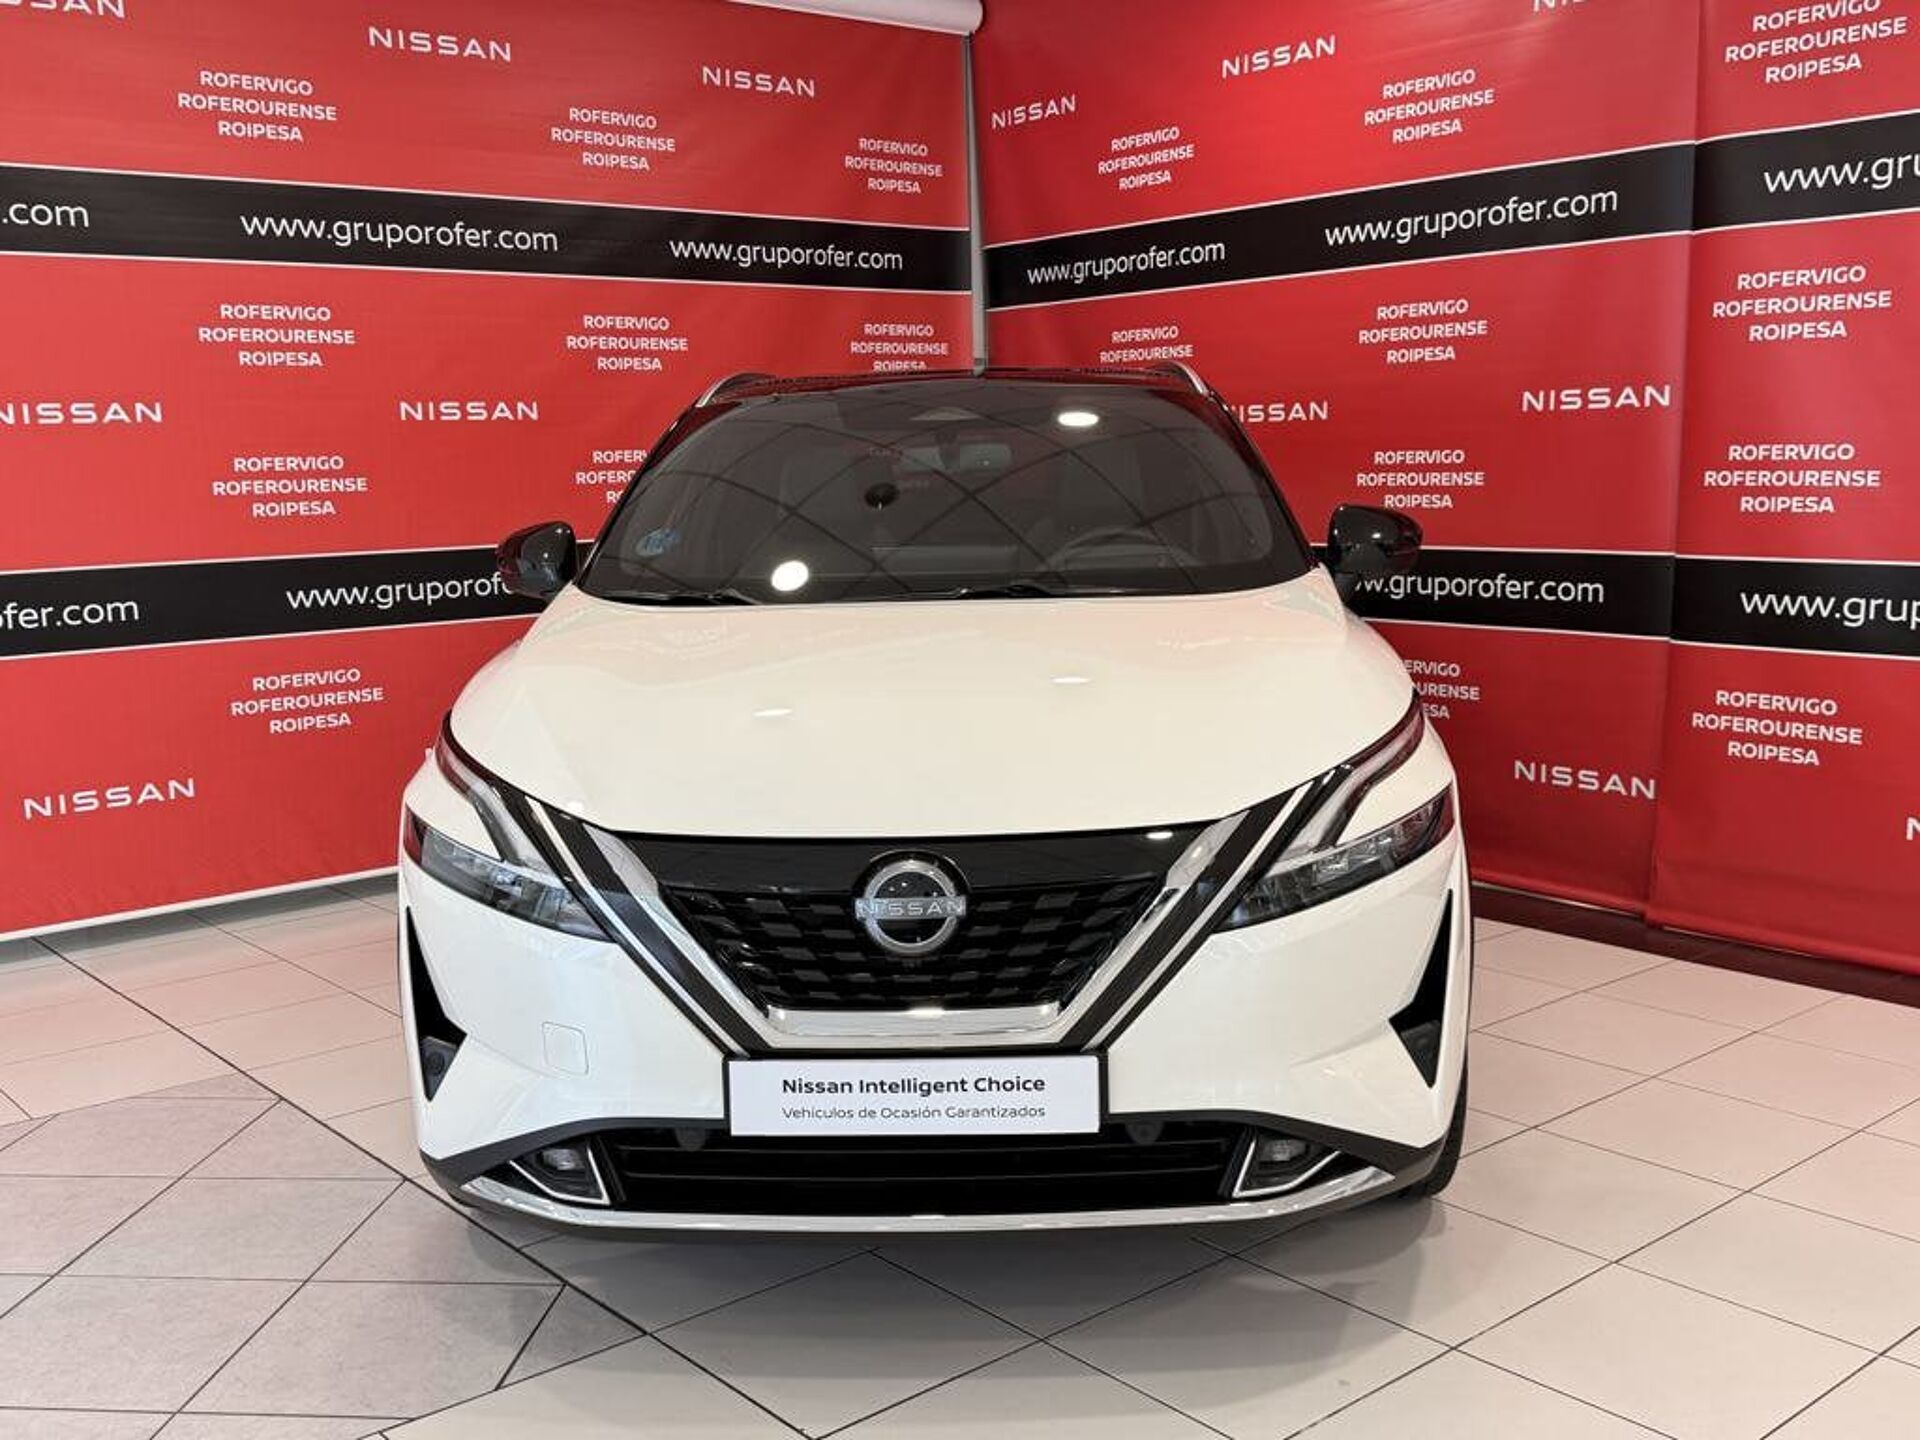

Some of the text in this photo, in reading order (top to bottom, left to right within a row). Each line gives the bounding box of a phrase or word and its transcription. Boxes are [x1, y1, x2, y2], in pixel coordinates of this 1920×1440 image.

[1754, 0, 1881, 31] ROFERVIGO
[369, 27, 510, 61] NISSAN
[1726, 16, 1907, 62] ROFEROURENSE
[1223, 36, 1335, 77] NISSAN
[1766, 54, 1861, 83] ROIPESA
[201, 71, 312, 95] ROFERVIGO
[703, 67, 814, 97] NISSAN
[1383, 69, 1475, 98] ROFERVIGO
[178, 93, 336, 120] ROFEROURENSE
[992, 95, 1075, 128] NISSAN
[1365, 89, 1493, 125] ROFEROURENSE
[570, 108, 656, 128] ROFERVIGO
[219, 121, 302, 140] ROIPESA
[552, 128, 675, 151] ROFEROURENSE
[1112, 127, 1179, 150] ROFERVIGO
[1393, 119, 1462, 142] ROIPESA
[859, 138, 928, 156] ROFERVIGO
[583, 152, 649, 169] ROIPESA
[845, 156, 942, 176] ROFEROURENSE
[1099, 145, 1193, 173] ROFEROURENSE
[868, 178, 921, 193] ROIPESA
[1120, 170, 1171, 189] ROIPESA
[1325, 191, 1617, 245] www.gruporofer.com
[241, 216, 557, 250] www.gruporofer.com
[670, 241, 902, 269] www.gruporofer.com
[1027, 243, 1225, 284] www.gruporofer.com
[1738, 266, 1865, 289] ROFERVIGO
[221, 305, 330, 320] ROFERVIGO
[1378, 299, 1468, 319] ROFERVIGO
[1714, 291, 1891, 317] ROFEROURENSE
[584, 316, 669, 330] ROFERVIGO
[865, 324, 933, 336] ROFERVIGO
[1359, 321, 1487, 343] ROFEROURENSE
[1750, 321, 1846, 340] ROIPESA
[199, 328, 354, 343] ROFEROURENSE
[567, 336, 687, 350] ROFEROURENSE
[1112, 326, 1178, 342] ROFERVIGO
[851, 342, 946, 354] ROFEROURENSE
[1101, 345, 1192, 362] ROFEROURENSE
[1387, 346, 1455, 362] ROIPESA
[239, 352, 322, 366] ROIPESA
[598, 357, 661, 370] ROIPESA
[1523, 385, 1670, 411] NISSAN
[400, 402, 537, 420] NISSAN
[1231, 402, 1328, 422] ISSAN
[1375, 450, 1464, 464] ROFERVIGO
[1730, 444, 1854, 459] ROFERVIGO
[234, 456, 343, 471] ROFERVIGO
[213, 478, 367, 495] ROFEROURENSE
[1358, 473, 1483, 485] ROFEROURENSE
[1705, 471, 1880, 486] ROFEROURENSE
[253, 501, 335, 517] ROIPESA
[1385, 495, 1452, 507] ROIPESA
[1741, 497, 1833, 512] ROIPESA
[0, 602, 138, 629] fer.com
[253, 669, 360, 690] ROFERVIGO
[231, 688, 383, 715] ROFEROURENSE
[1716, 691, 1837, 715] ROFERVIGO
[270, 713, 351, 733] ROIPESA
[1693, 713, 1862, 744] ROFEROURENSE
[1728, 741, 1819, 765] ROIPESA
[1515, 761, 1654, 799] NISSAN
[24, 779, 194, 819] NISSAN
[861, 900, 962, 916] NISSAN
[782, 1076, 1046, 1097] Nissan Intelligent Choice
[858, 1107, 877, 1118] de
[944, 1106, 1046, 1118] Garantizados
